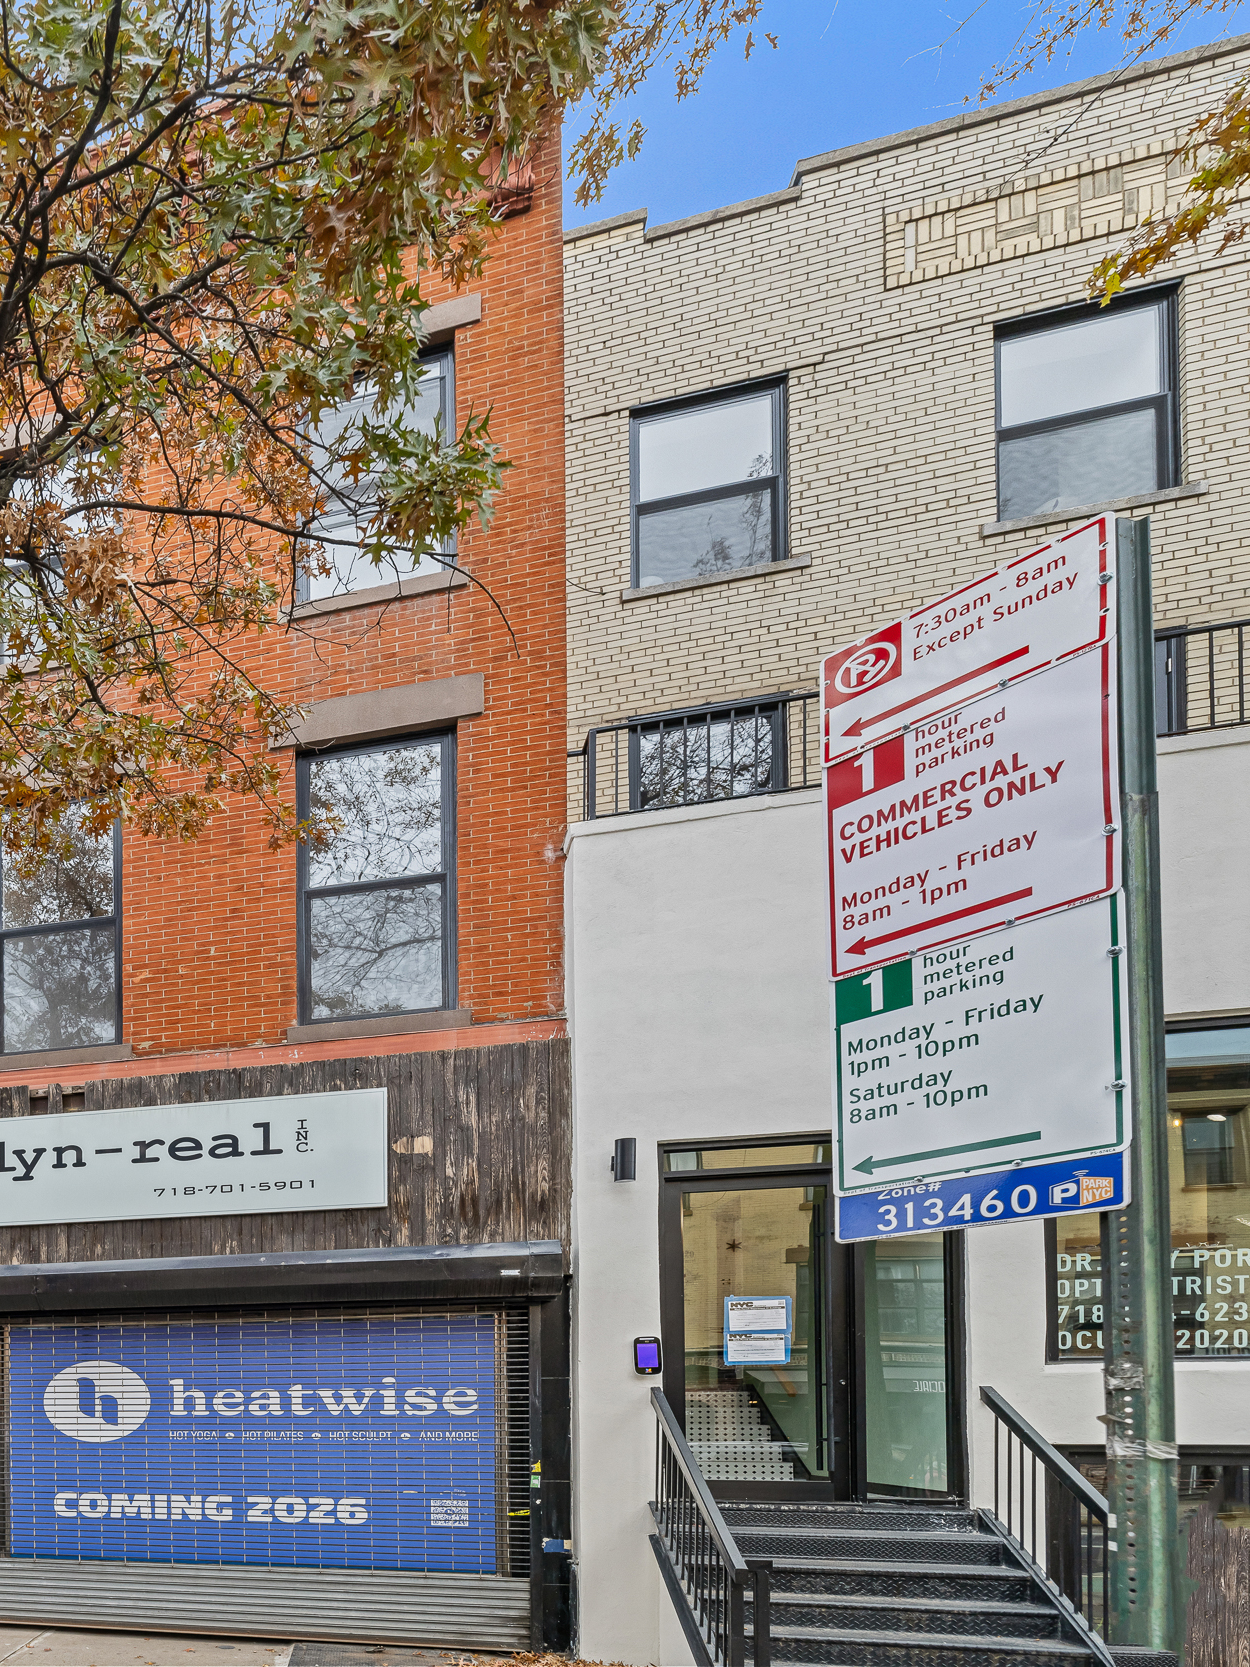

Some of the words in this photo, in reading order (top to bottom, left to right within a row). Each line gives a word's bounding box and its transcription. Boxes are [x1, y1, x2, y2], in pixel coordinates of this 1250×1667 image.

[913, 590, 990, 639] 7:30am
[1016, 555, 1067, 589] 8am
[913, 615, 984, 661] Except
[993, 572, 1079, 623] Sunday
[914, 711, 963, 742] hour
[915, 707, 1006, 759] metered
[853, 748, 875, 793] 1
[915, 731, 995, 778] parking
[839, 752, 1029, 841] COMMERCIAL
[840, 798, 972, 864] VEHICLES
[984, 760, 1065, 809] ONLY
[842, 869, 930, 912] Monday
[957, 831, 1037, 871] Friday
[842, 904, 891, 931] 8am
[918, 878, 967, 906] 1pm
[923, 944, 971, 969] hour
[924, 946, 1014, 985] metered
[862, 969, 884, 1012] 1
[924, 970, 1004, 1005] parking
[848, 1023, 934, 1056] Monday
[965, 994, 1044, 1026] Friday
[848, 1053, 889, 1077] 1pm
[915, 1031, 979, 1059] 10pm
[849, 1070, 952, 1104] Saturday
[850, 1101, 897, 1124] 8am
[923, 1082, 988, 1109] 10pm
[295, 1118, 314, 1153] INC.
[153, 1179, 315, 1198] 718-701-5901
[877, 1181, 942, 1200] Zone#
[1083, 1179, 1110, 1189] PARK
[1083, 1187, 1110, 1203] NYC
[876, 1184, 1037, 1231] 313460
[1057, 1253, 1102, 1272] DR.
[169, 1377, 478, 1416] heatwise
[169, 1431, 189, 1441] HOT
[191, 1431, 217, 1441] YOGA
[242, 1431, 264, 1441] HOT
[265, 1431, 304, 1441] PILATES
[329, 1431, 350, 1441] HOT
[352, 1431, 392, 1441] SCULPT
[419, 1431, 444, 1441] AND
[446, 1431, 479, 1441] MORE
[54, 1491, 233, 1521] COMING
[247, 1495, 368, 1525] 2026
